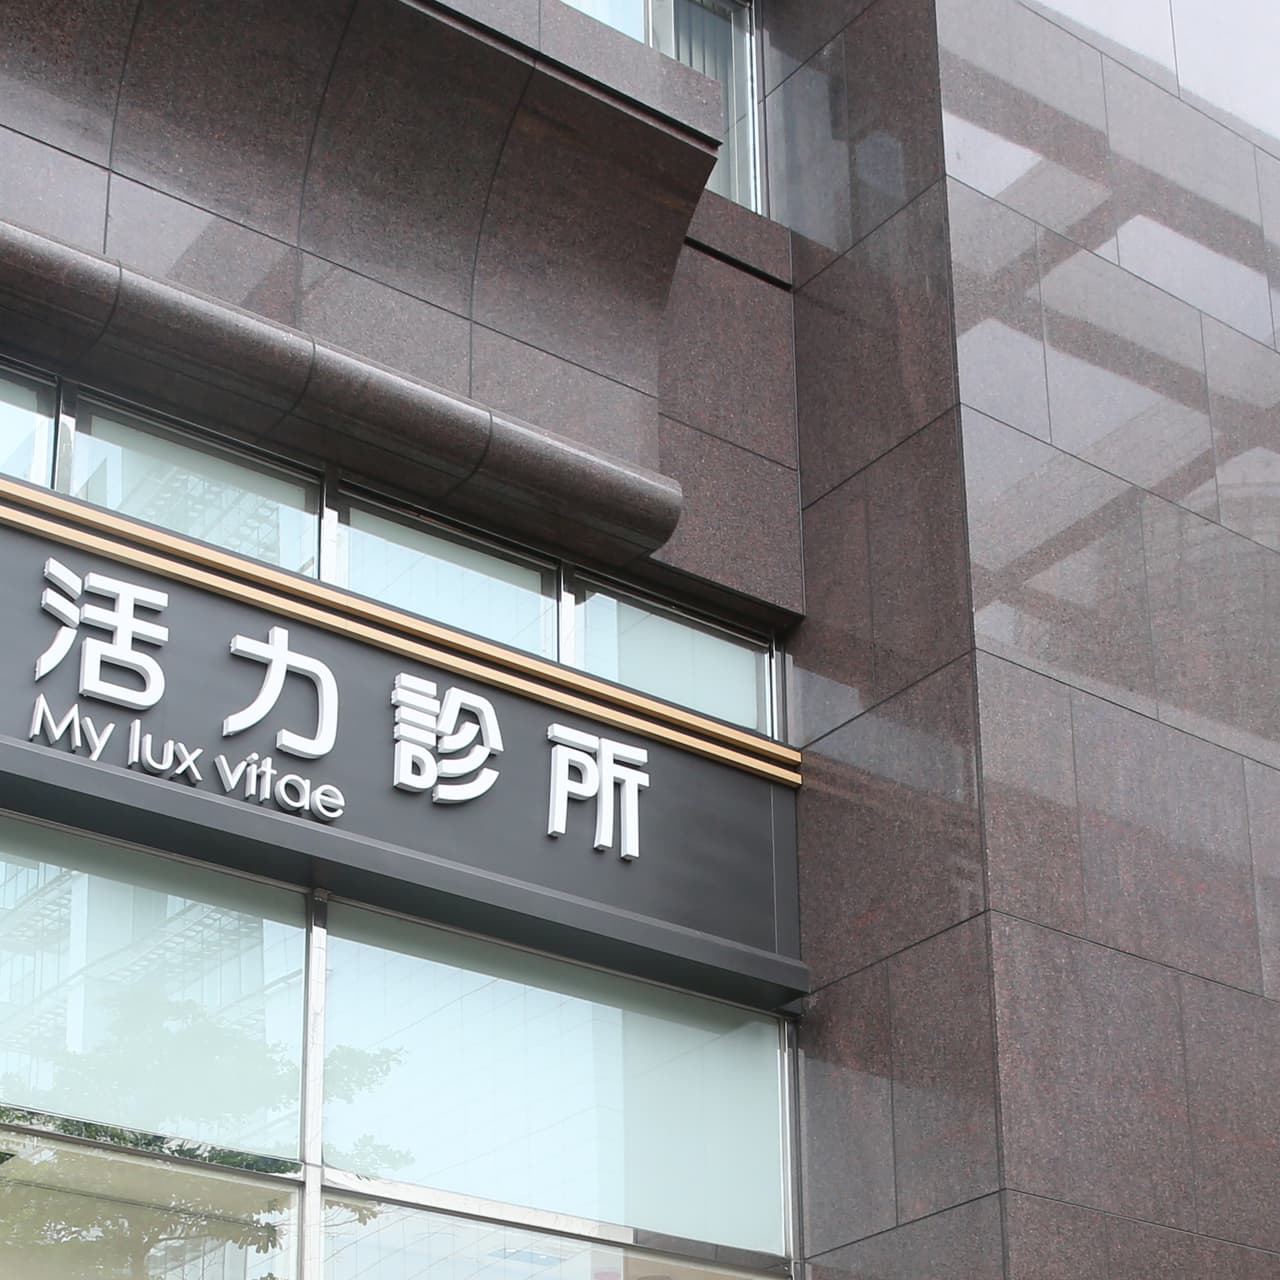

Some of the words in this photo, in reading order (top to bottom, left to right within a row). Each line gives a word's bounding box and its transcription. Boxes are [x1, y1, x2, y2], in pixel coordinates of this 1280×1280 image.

[29, 693, 115, 762] My
[127, 718, 204, 784] lux
[213, 751, 345, 819] vitae
